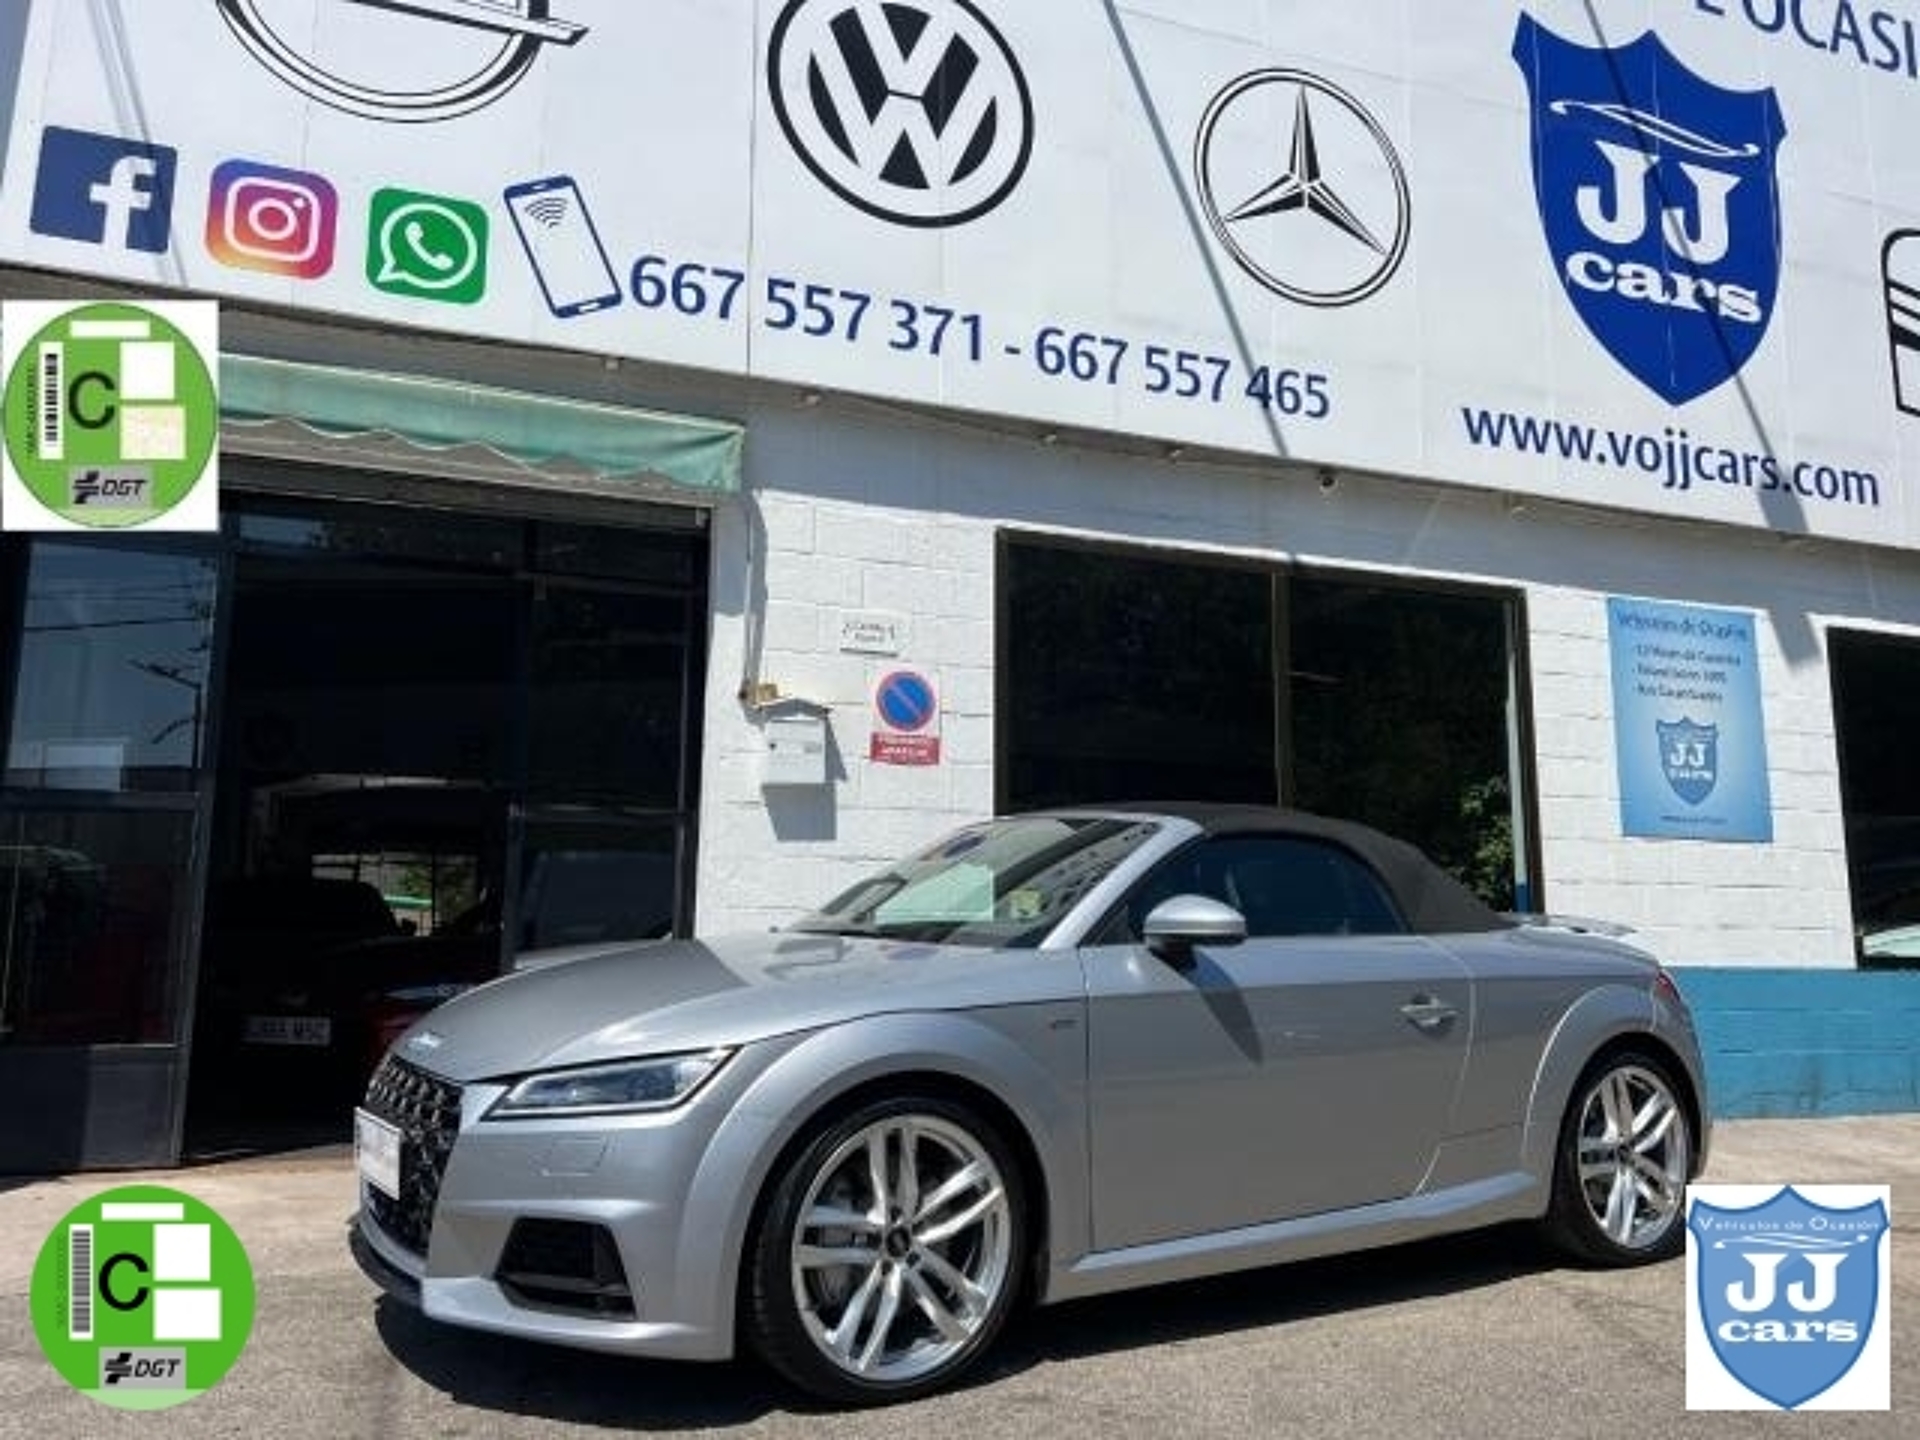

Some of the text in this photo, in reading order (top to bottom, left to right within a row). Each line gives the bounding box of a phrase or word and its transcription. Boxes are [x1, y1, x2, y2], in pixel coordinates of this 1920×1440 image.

[1576, 139, 1742, 265] JJ
[630, 254, 745, 320] 667
[764, 277, 871, 342] 557
[888, 299, 982, 362] 371
[1035, 327, 1129, 385] 667
[1145, 345, 1231, 403] 557
[1245, 366, 1330, 419] 465
[1566, 251, 1762, 323] cars
[1462, 407, 1880, 506] www.vojjcars.com
[1669, 743, 1707, 766] JJ
